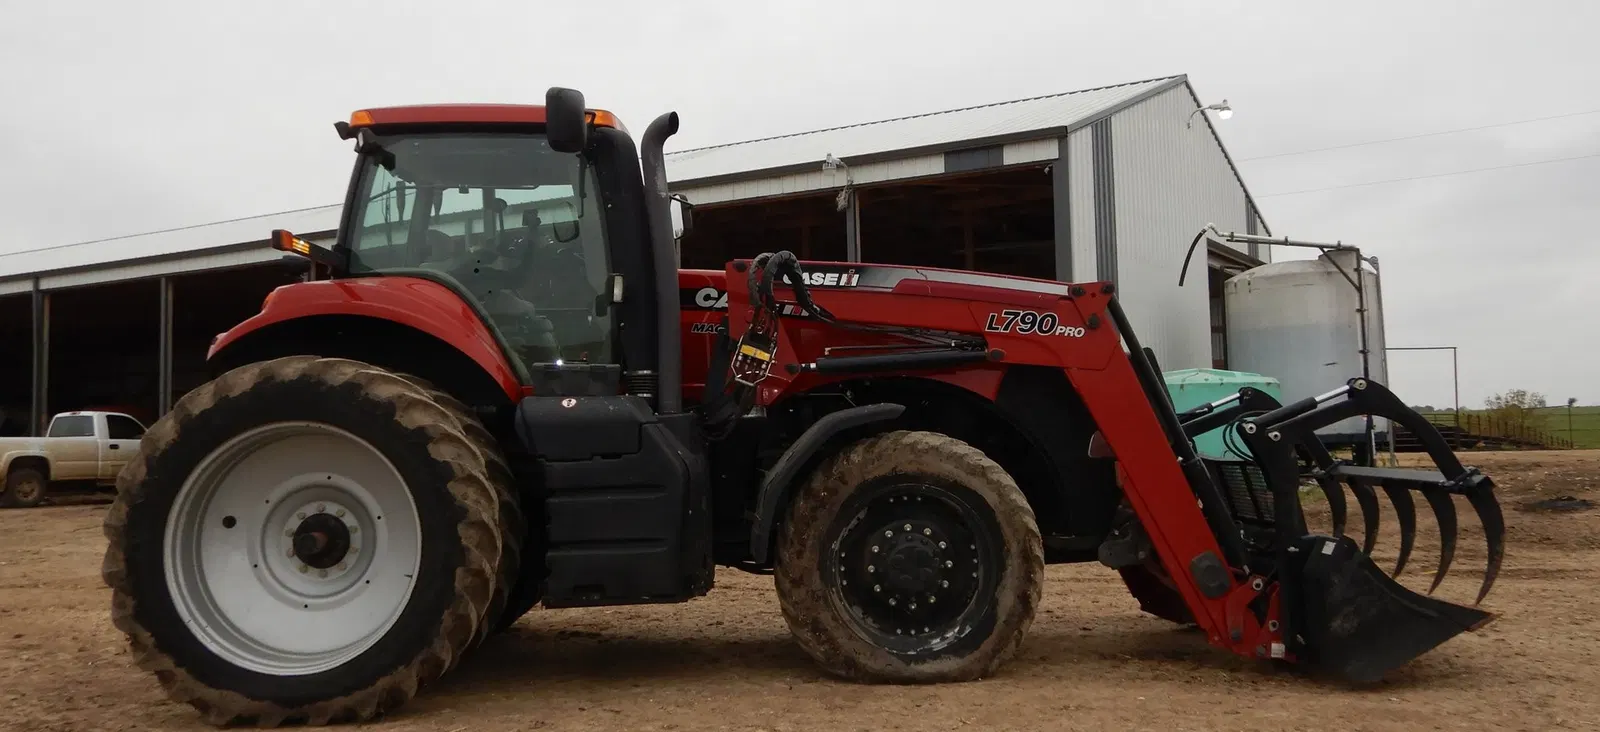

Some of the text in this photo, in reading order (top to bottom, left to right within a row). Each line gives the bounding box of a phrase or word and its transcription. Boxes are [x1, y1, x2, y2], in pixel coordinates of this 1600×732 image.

[694, 287, 729, 308] CA
[691, 323, 724, 334] MAG
[1056, 326, 1085, 337] PRO
